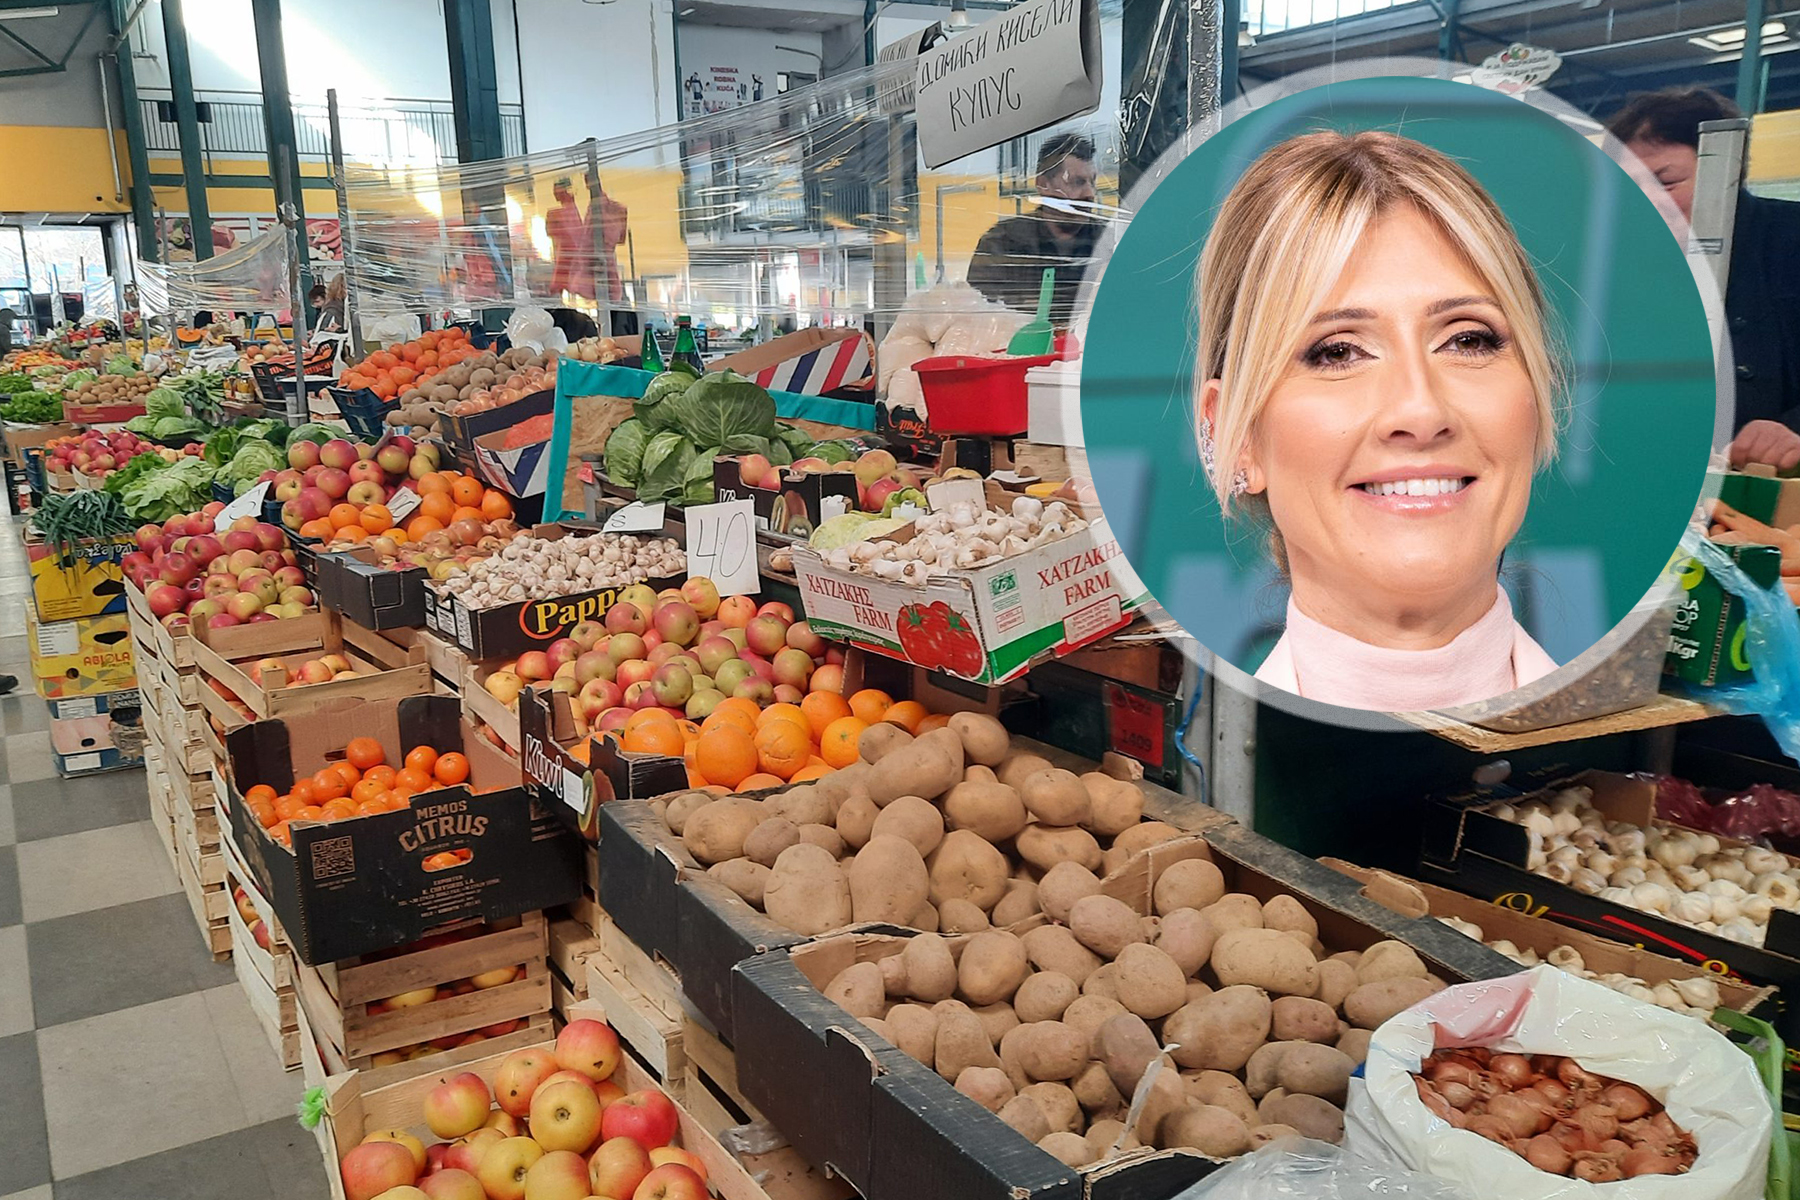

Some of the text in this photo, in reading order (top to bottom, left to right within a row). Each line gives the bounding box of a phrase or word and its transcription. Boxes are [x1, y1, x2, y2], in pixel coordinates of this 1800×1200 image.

[996, 0, 1075, 54] КИСЕЛИ
[949, 67, 1022, 132] КУПУС
[696, 511, 749, 580] 40
[1037, 539, 1123, 590] ΧΑΤΖΑΚΗ
[533, 580, 625, 635] Papp
[1063, 570, 1111, 607] FARM
[852, 604, 893, 632] FARM
[83, 651, 131, 667] ABIOLA
[524, 732, 563, 799] Kiwi
[398, 814, 489, 853] CITRUS
[416, 799, 468, 820] MEMOS
